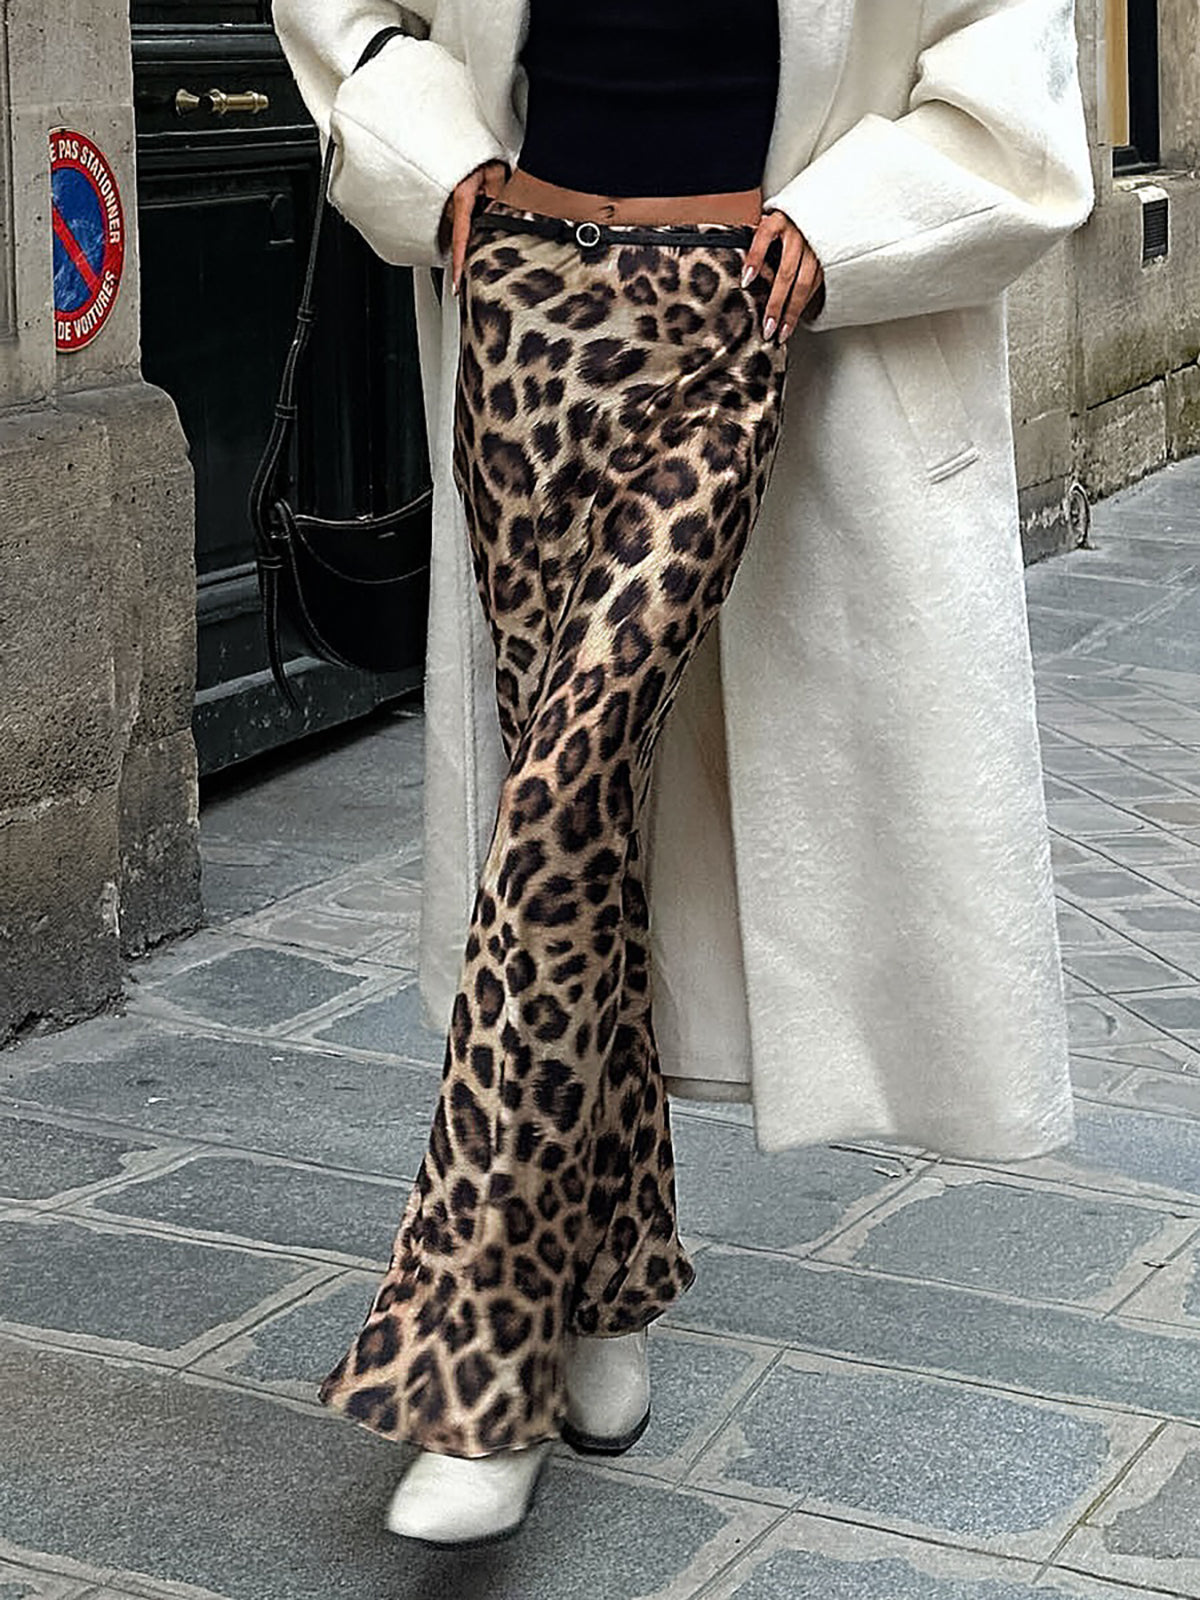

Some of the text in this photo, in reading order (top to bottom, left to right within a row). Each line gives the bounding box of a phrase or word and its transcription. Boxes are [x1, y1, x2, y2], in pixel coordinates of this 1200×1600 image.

[49, 139, 120, 244] E PAS STATIONNER
[57, 270, 115, 341] DE VOITURES
